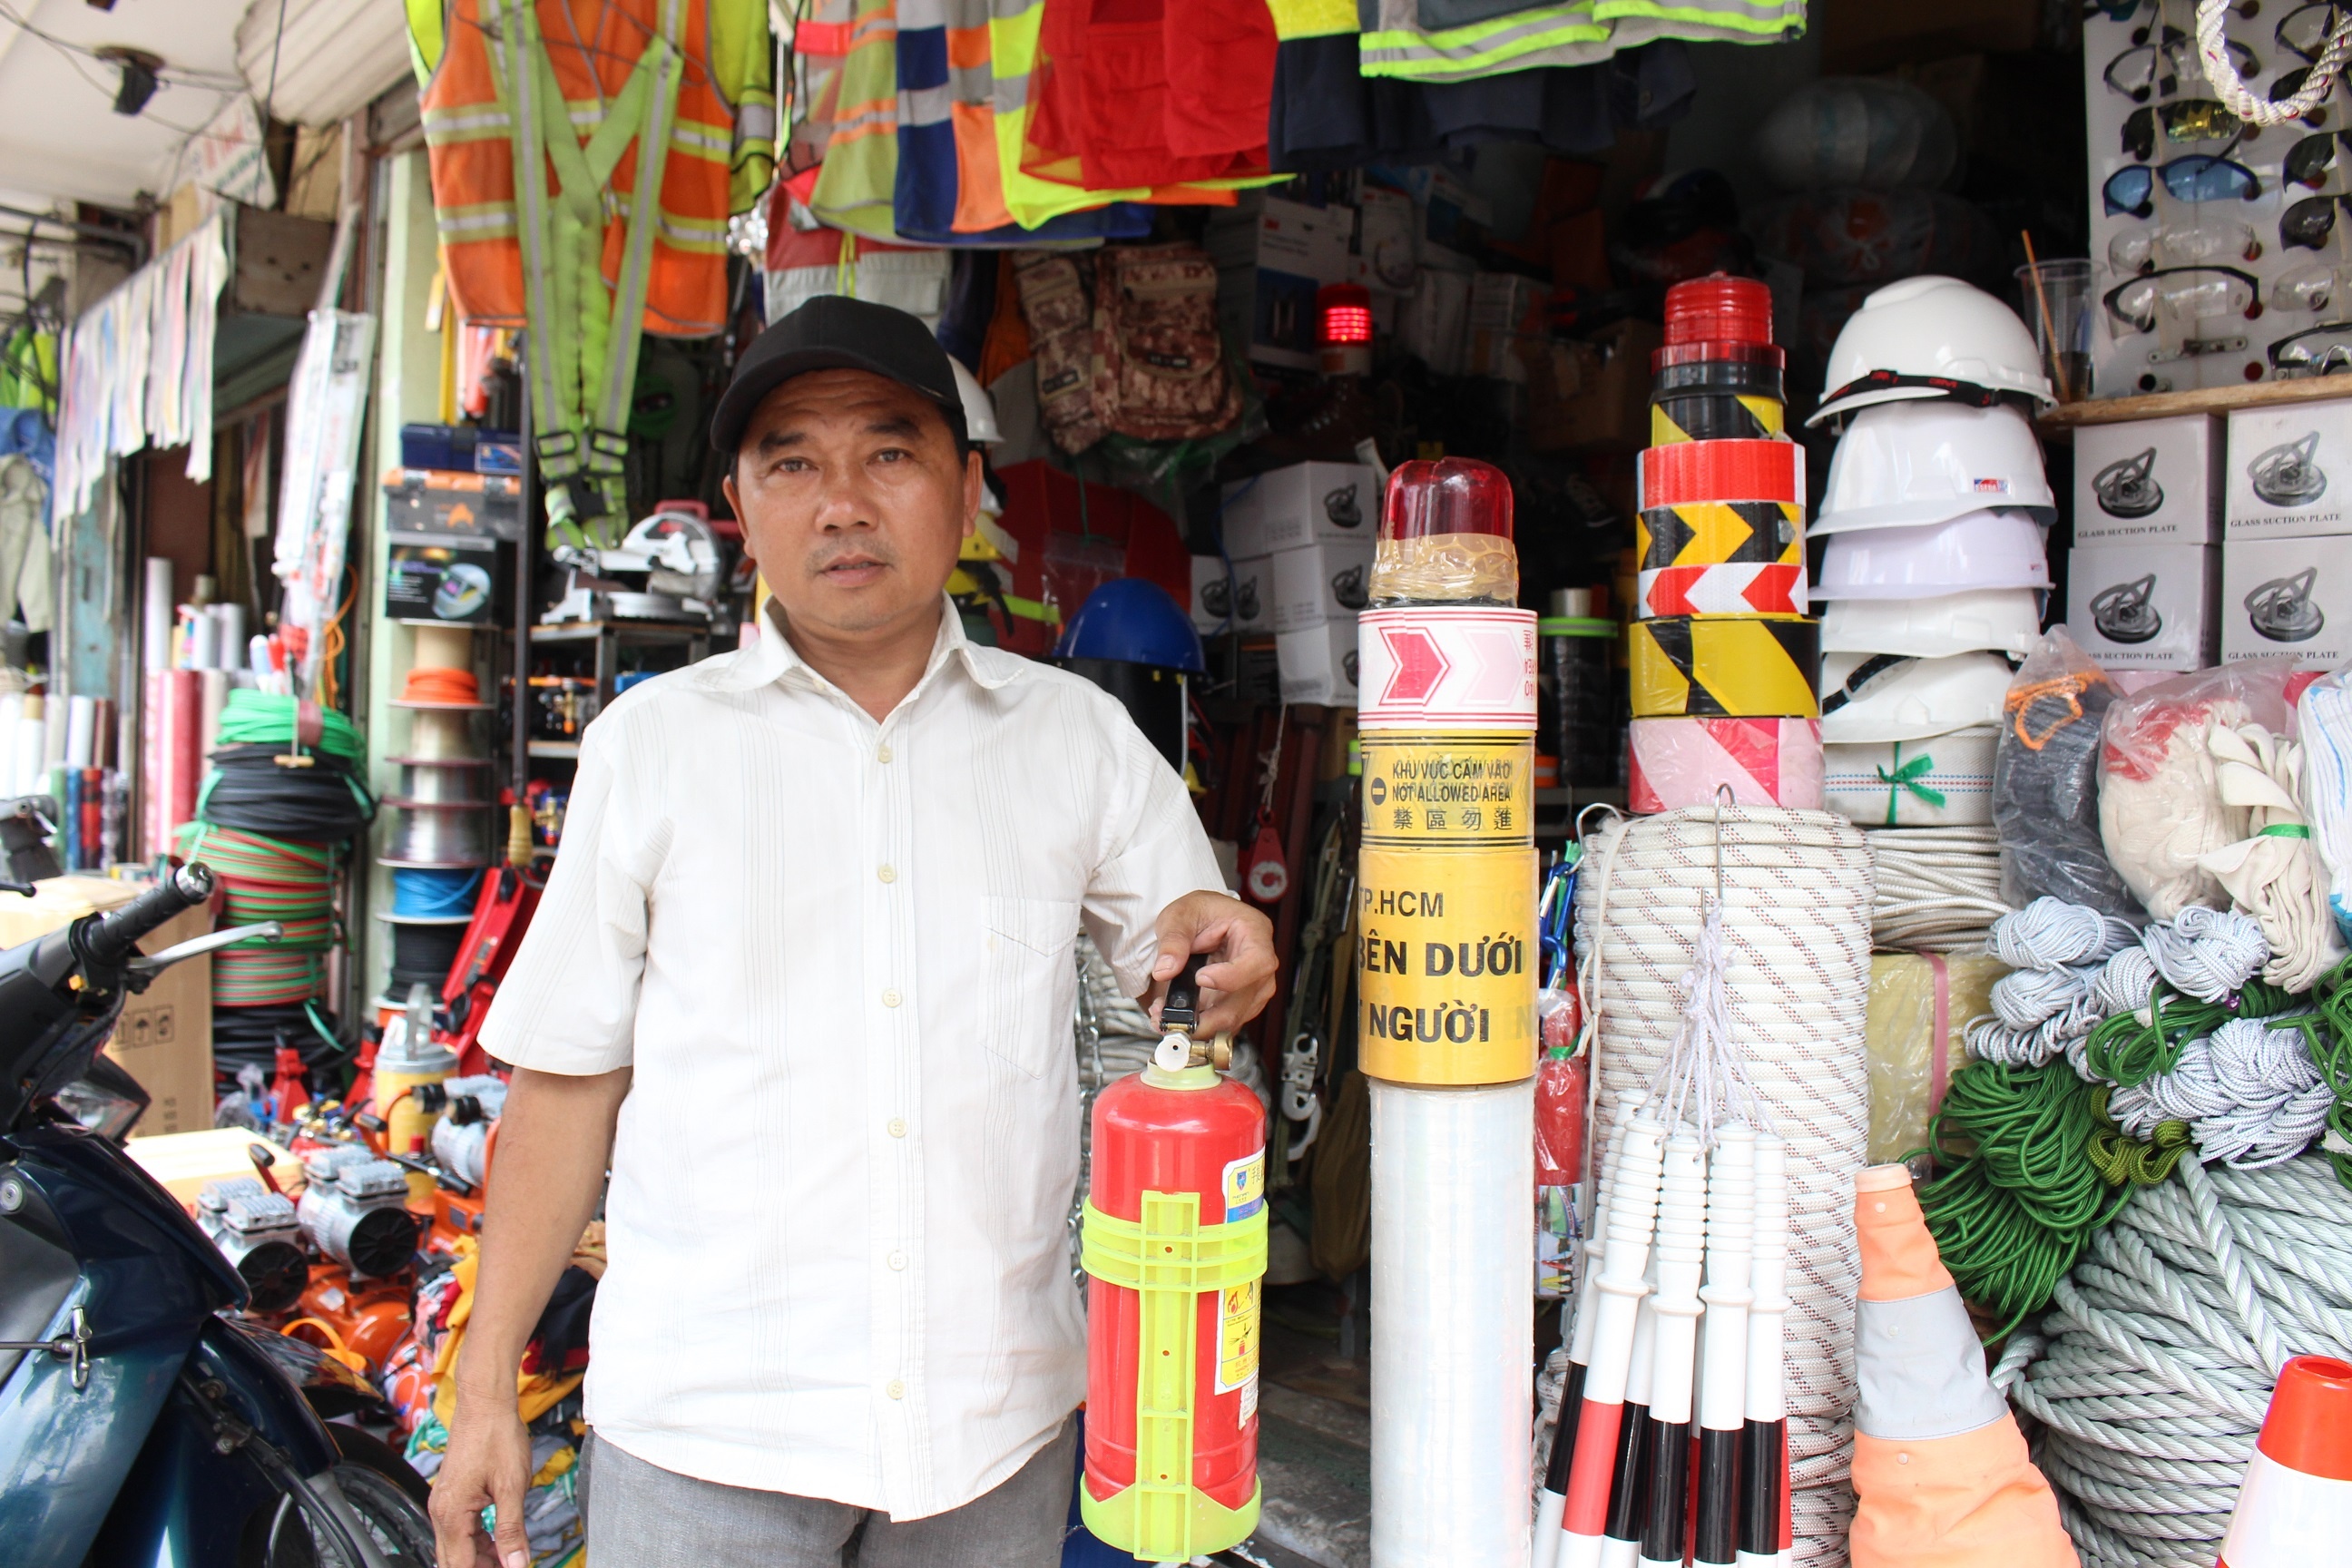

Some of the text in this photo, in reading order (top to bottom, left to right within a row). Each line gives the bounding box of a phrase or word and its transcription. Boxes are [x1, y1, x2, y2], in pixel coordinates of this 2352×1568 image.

[2230, 513, 2341, 528] GLASS SUCTION PLATE
[2078, 524, 2177, 539] GLASS SUCTION PLATE
[2104, 652, 2142, 661] SUCTION
[2145, 652, 2175, 661] PLATE
[2306, 651, 2339, 660] PLATE
[1453, 756, 1484, 779] CẤM
[1392, 785, 1511, 802] NOT ALLOWED AREA
[1425, 931, 1523, 977] DƯỚI
[1369, 999, 1490, 1044] NGƯỜI
